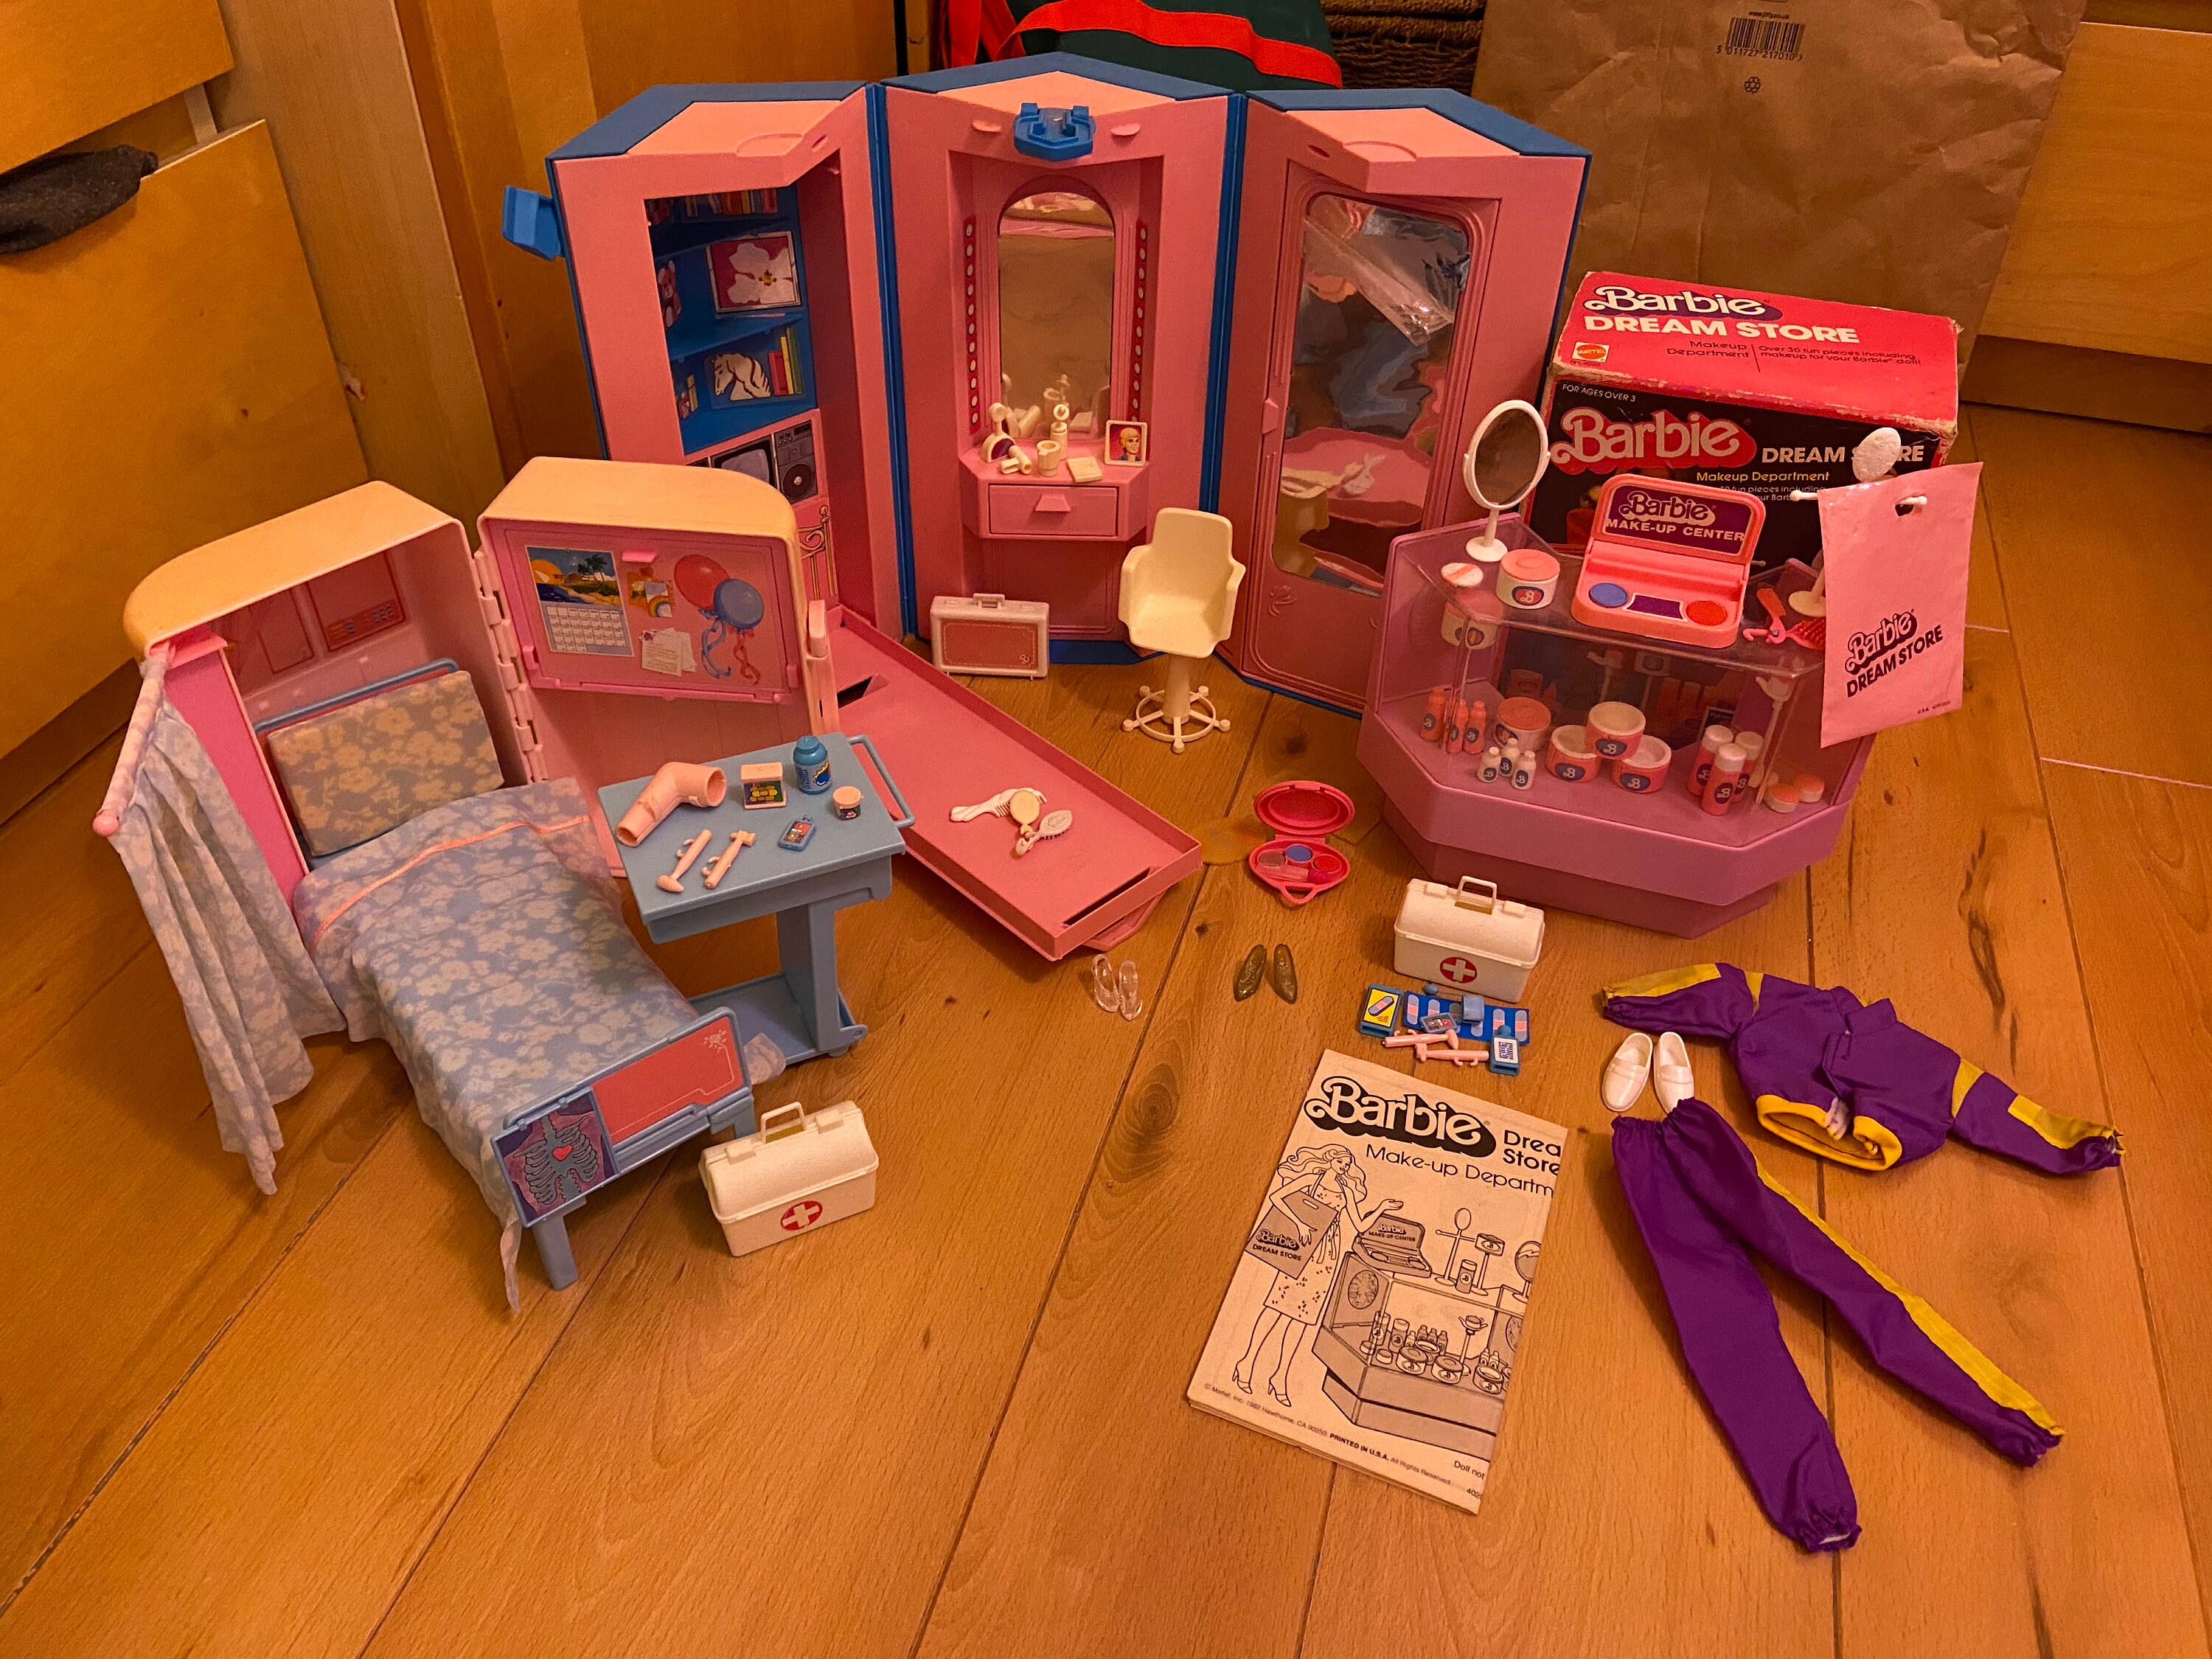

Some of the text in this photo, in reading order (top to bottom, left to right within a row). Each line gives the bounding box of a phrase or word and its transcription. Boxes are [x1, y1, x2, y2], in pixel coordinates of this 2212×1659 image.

[1584, 285, 1767, 316] Barbie
[1584, 316, 1860, 344] DREAM STORE
[1666, 348, 1750, 359] Department
[1689, 341, 1747, 352] Makeup
[1761, 351, 1807, 360] makeup
[1809, 352, 1825, 360] for
[1826, 354, 1851, 362] your
[1822, 349, 1860, 358] pieces
[1562, 383, 1636, 403] FOR AGES OVER 3
[1549, 407, 1742, 464] Barbie
[1761, 446, 1846, 463] DREAM
[1696, 471, 1829, 484] Makeup Department
[1747, 485, 1779, 494] pieces
[1618, 490, 1711, 523] Barbie
[1606, 518, 1746, 542] MAKE-UP CENTER
[1845, 611, 1917, 675] Barbie
[1846, 625, 1944, 698] DREAM STORE
[1304, 1076, 1485, 1149] Barbie
[1503, 1129, 1562, 1158] Drea
[1366, 1144, 1554, 1198] Make-up Departm
[1503, 1148, 1560, 1177] Store
[1256, 1228, 1300, 1251] Barbie
[1368, 1231, 1416, 1242] MAKE-UP CENTER
[1377, 1223, 1406, 1235] Barbie
[1252, 1243, 1302, 1262] DREAM STORE
[1296, 1420, 1307, 1429] CA
[1329, 1433, 1360, 1450] PRINTED
[1369, 1448, 1389, 1461] U.S.A.
[1391, 1456, 1399, 1464] All
[1399, 1460, 1419, 1474] Rights
[1454, 1460, 1485, 1481] Doll not
